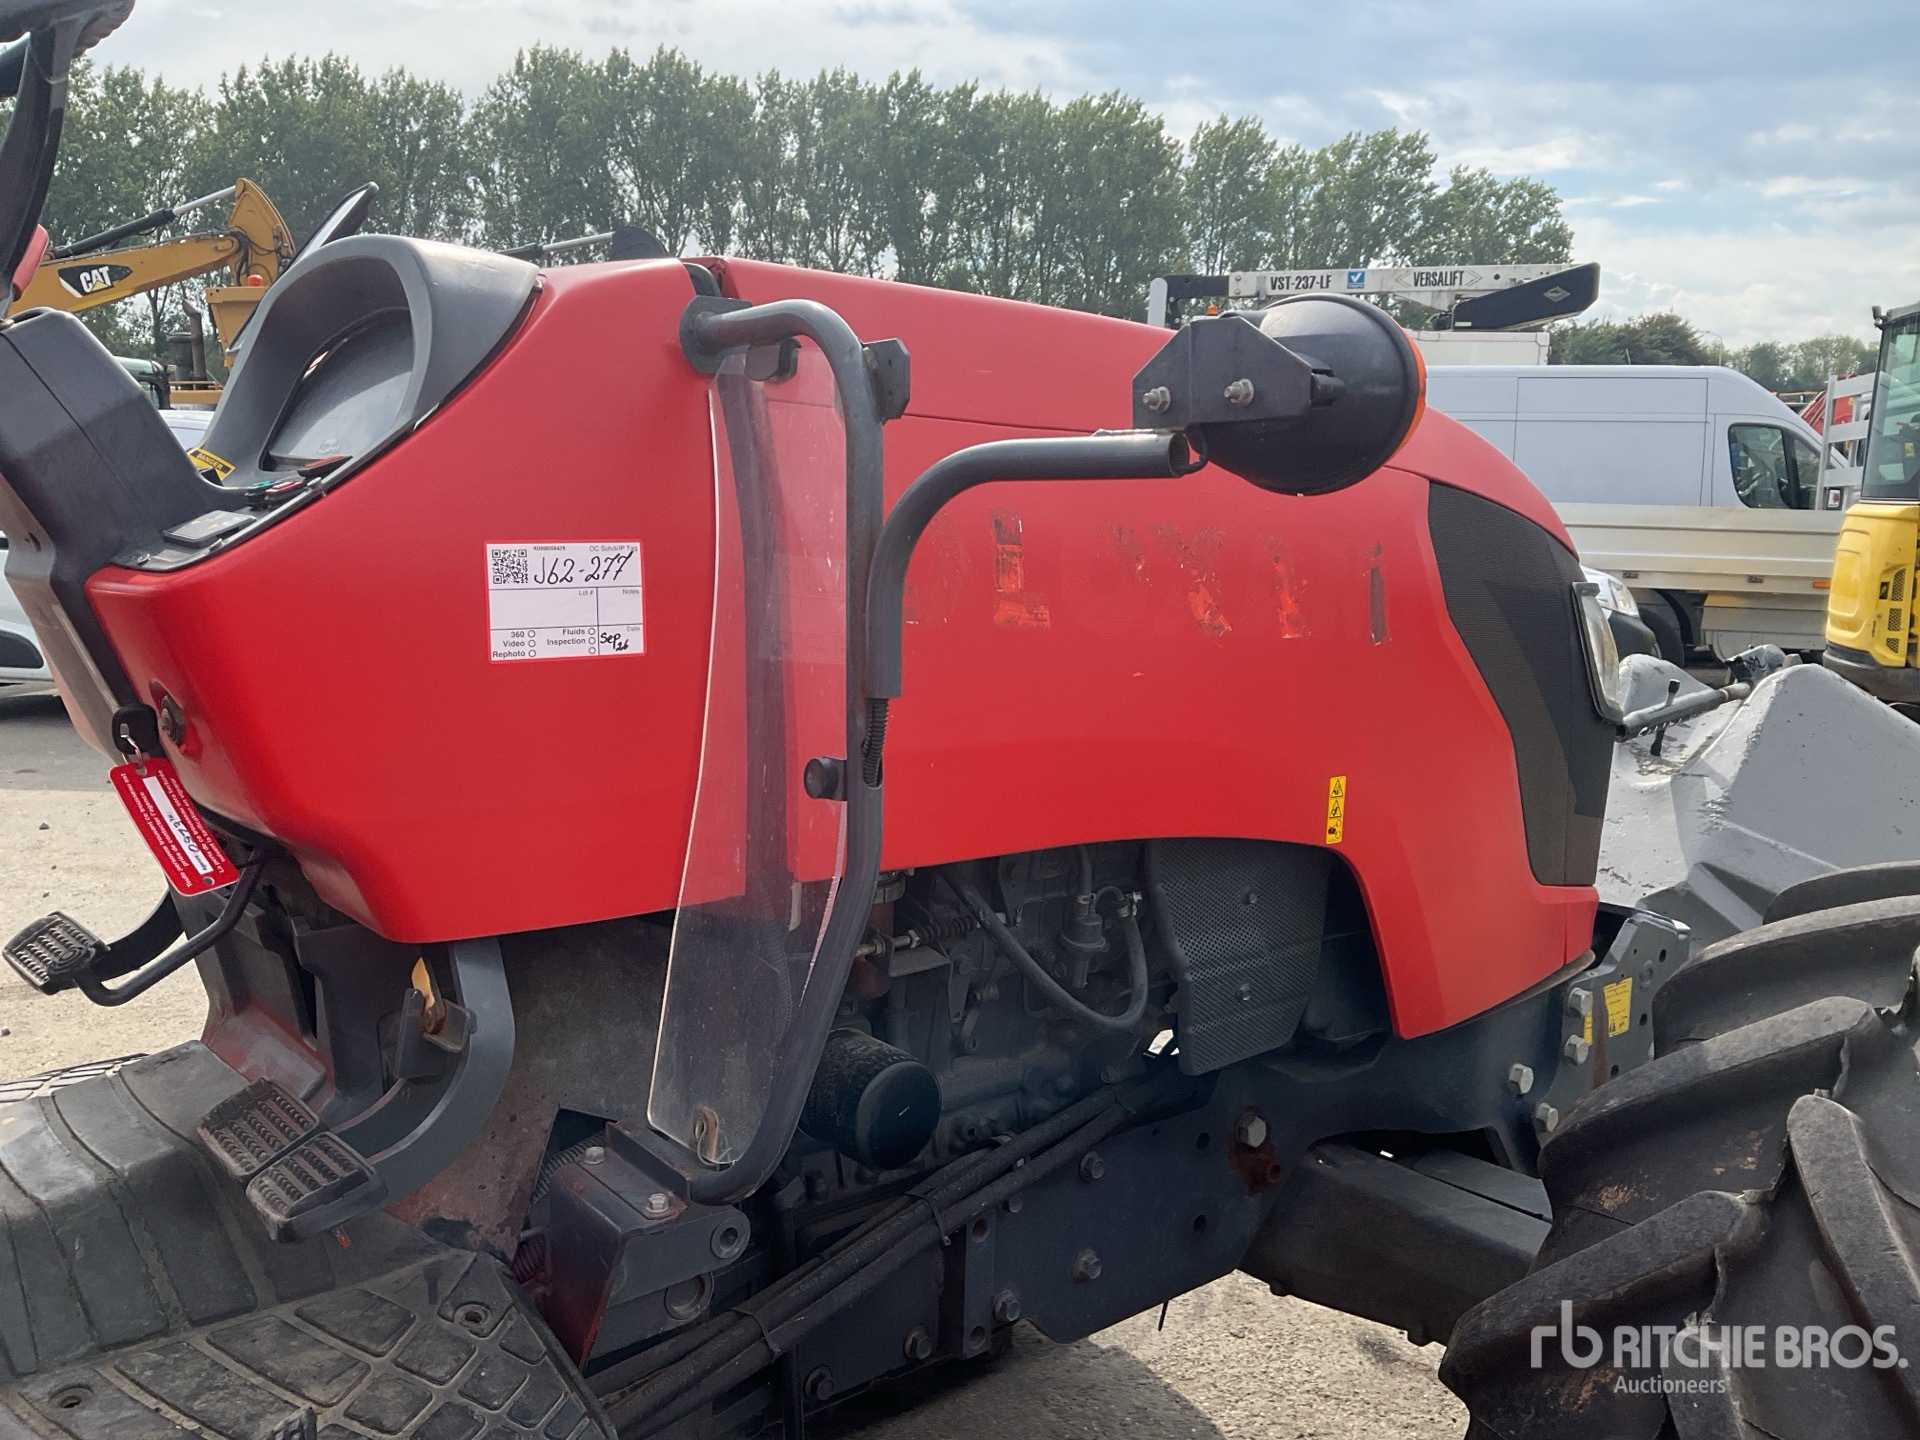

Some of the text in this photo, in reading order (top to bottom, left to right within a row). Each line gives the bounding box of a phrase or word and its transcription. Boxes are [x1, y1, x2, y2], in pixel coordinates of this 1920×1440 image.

[80, 266, 111, 292] CAT
[1270, 274, 1332, 291] VST-237-LF
[1413, 270, 1464, 287] VERSALIFT
[196, 453, 224, 469] DANGER
[533, 550, 634, 585] J62-277
[562, 628, 586, 636] Fluids
[600, 632, 621, 649] Sep
[547, 638, 586, 646] Inspection
[492, 650, 526, 658] Rephoto
